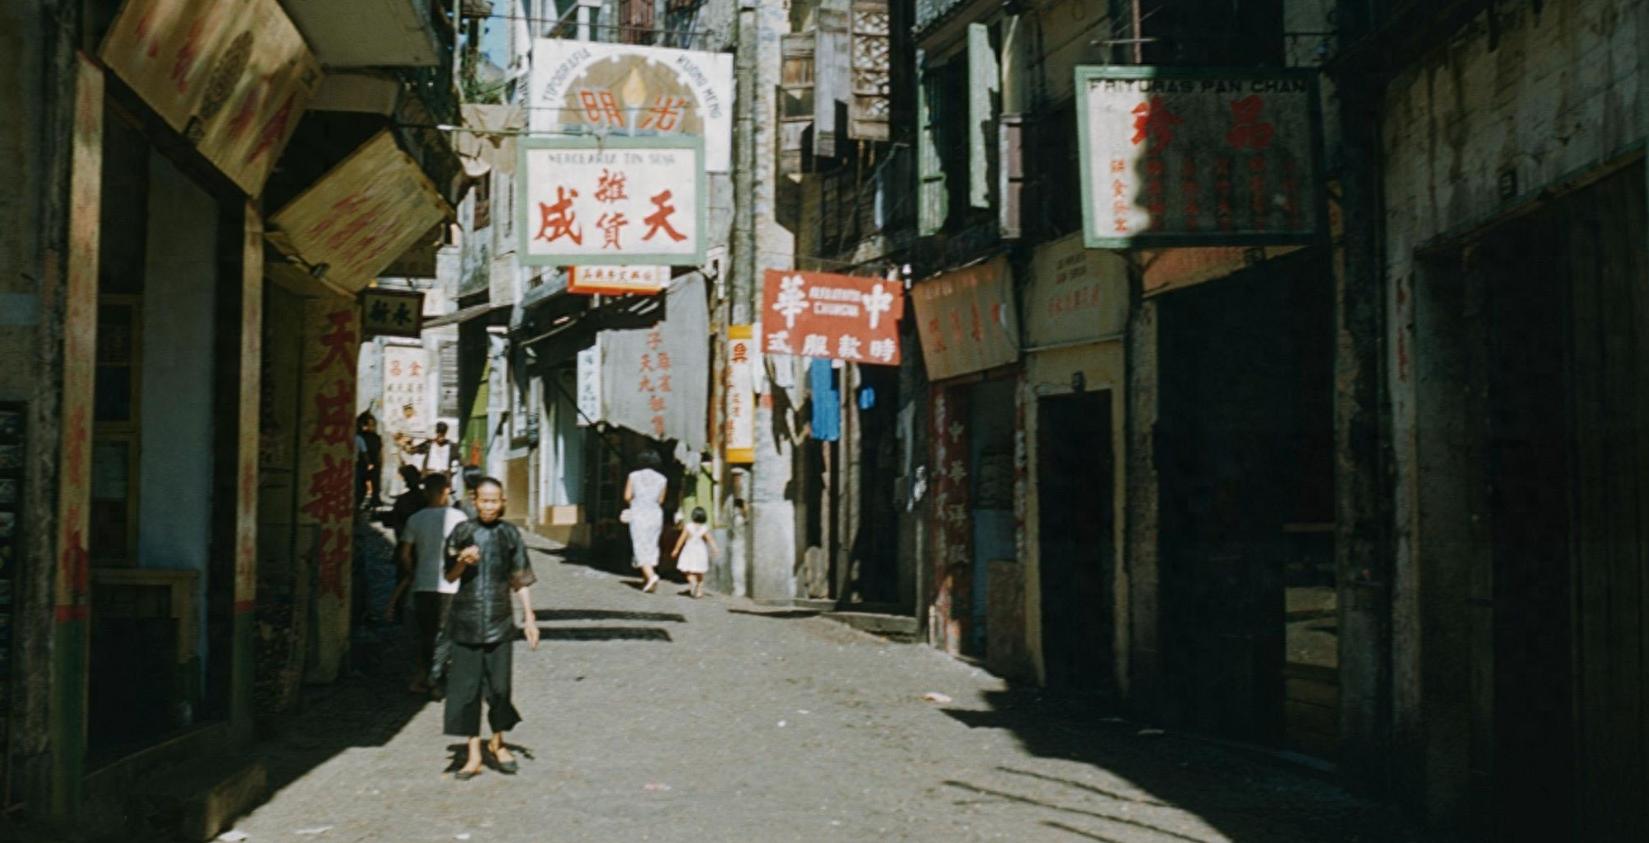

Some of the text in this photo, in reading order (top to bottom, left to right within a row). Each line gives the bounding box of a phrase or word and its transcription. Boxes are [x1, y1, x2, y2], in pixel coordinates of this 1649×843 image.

[1089, 79, 1308, 93] FRITURAS PAN CHAN
